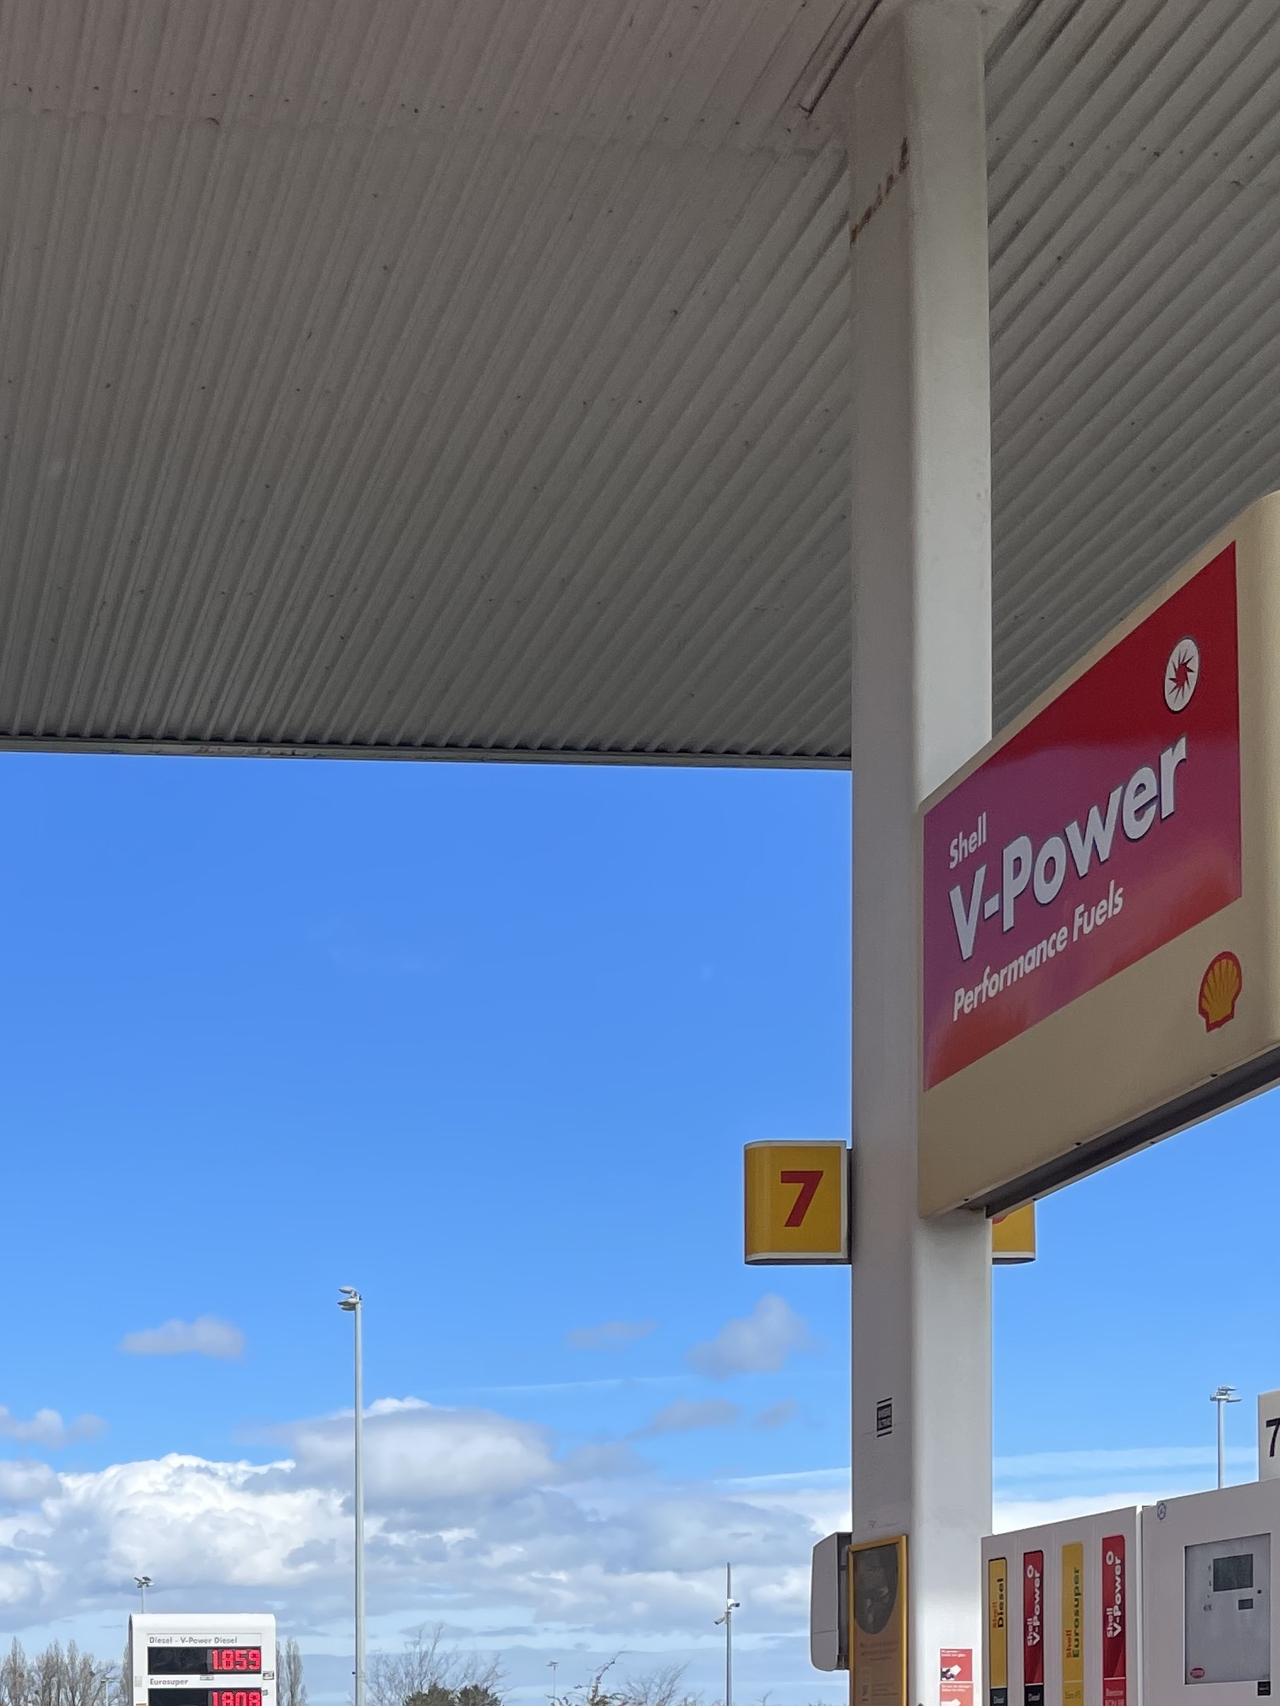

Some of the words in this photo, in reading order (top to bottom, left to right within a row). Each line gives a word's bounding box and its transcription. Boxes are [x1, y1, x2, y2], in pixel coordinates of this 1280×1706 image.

[949, 811, 987, 869] Shell
[949, 735, 1188, 962] V-Power
[952, 925, 1068, 1022] Performance
[1071, 879, 1124, 943] Fuels
[780, 1170, 824, 1228] 7
[1266, 1417, 1280, 1458] 7
[1032, 1569, 1041, 1647] V-Power
[1073, 1567, 1082, 1659] Eurosuper
[1106, 1607, 1114, 1639] Shell
[1113, 1556, 1122, 1639] V-Power
[149, 1636, 173, 1644] Diesel
[180, 1636, 212, 1645] V-Power
[214, 1636, 238, 1644] Diesel
[212, 1649, 261, 1671] 1.859
[149, 1678, 189, 1688] Eurosuper
